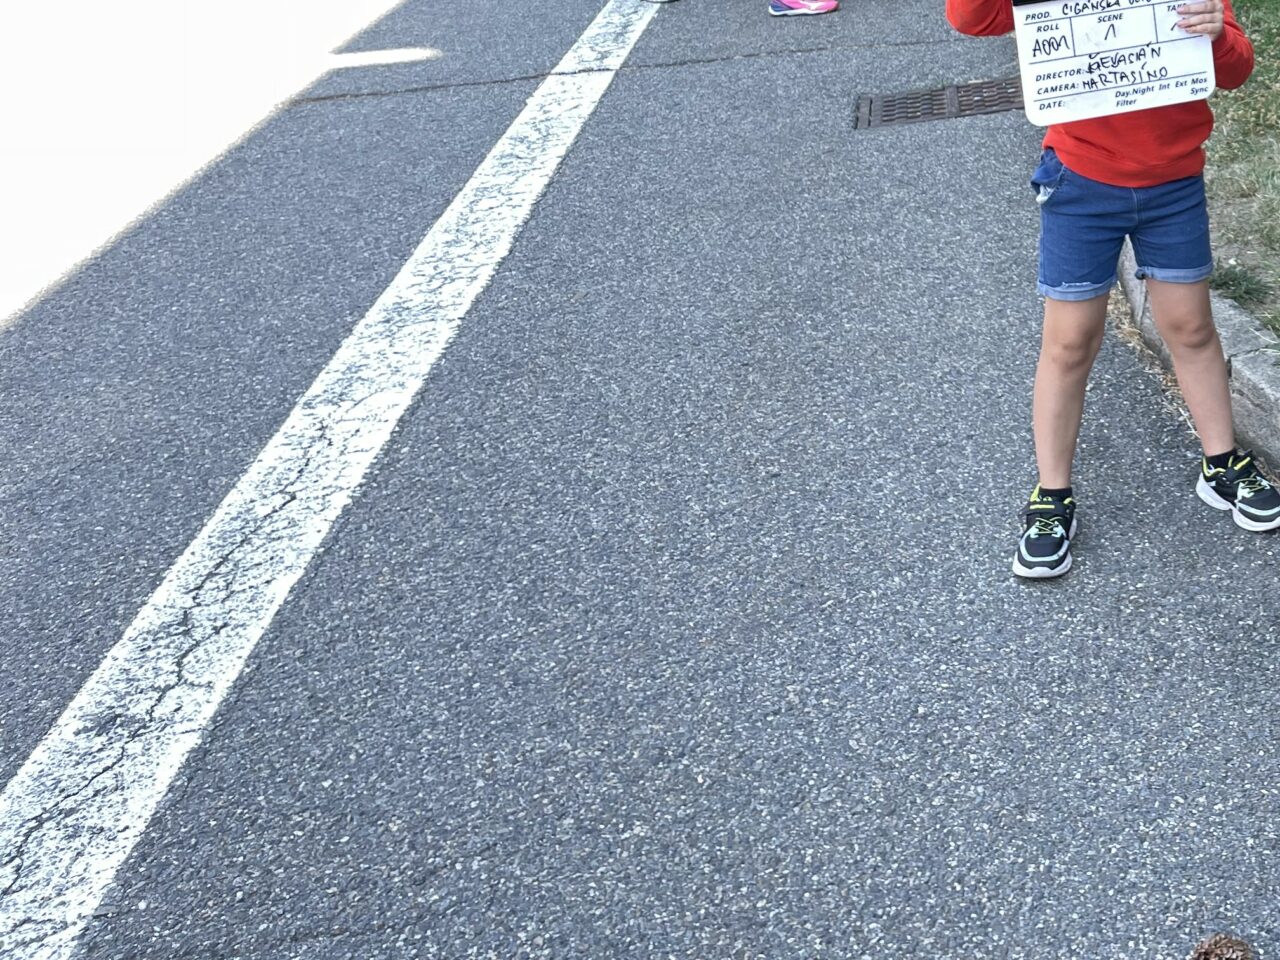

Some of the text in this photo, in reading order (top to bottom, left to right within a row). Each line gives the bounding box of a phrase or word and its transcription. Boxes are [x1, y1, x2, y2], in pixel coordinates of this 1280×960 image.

[1097, 12, 1124, 23] SCENE
[1036, 23, 1060, 33] ROLL
[1036, 68, 1085, 82] DIRECTOR:
[1037, 82, 1080, 95] CAMERA:
[1159, 82, 1170, 91] Int
[1174, 80, 1187, 88] Ext
[1190, 77, 1208, 85] Mos
[1190, 86, 1209, 96] Sync
[1116, 98, 1137, 108] Filter
